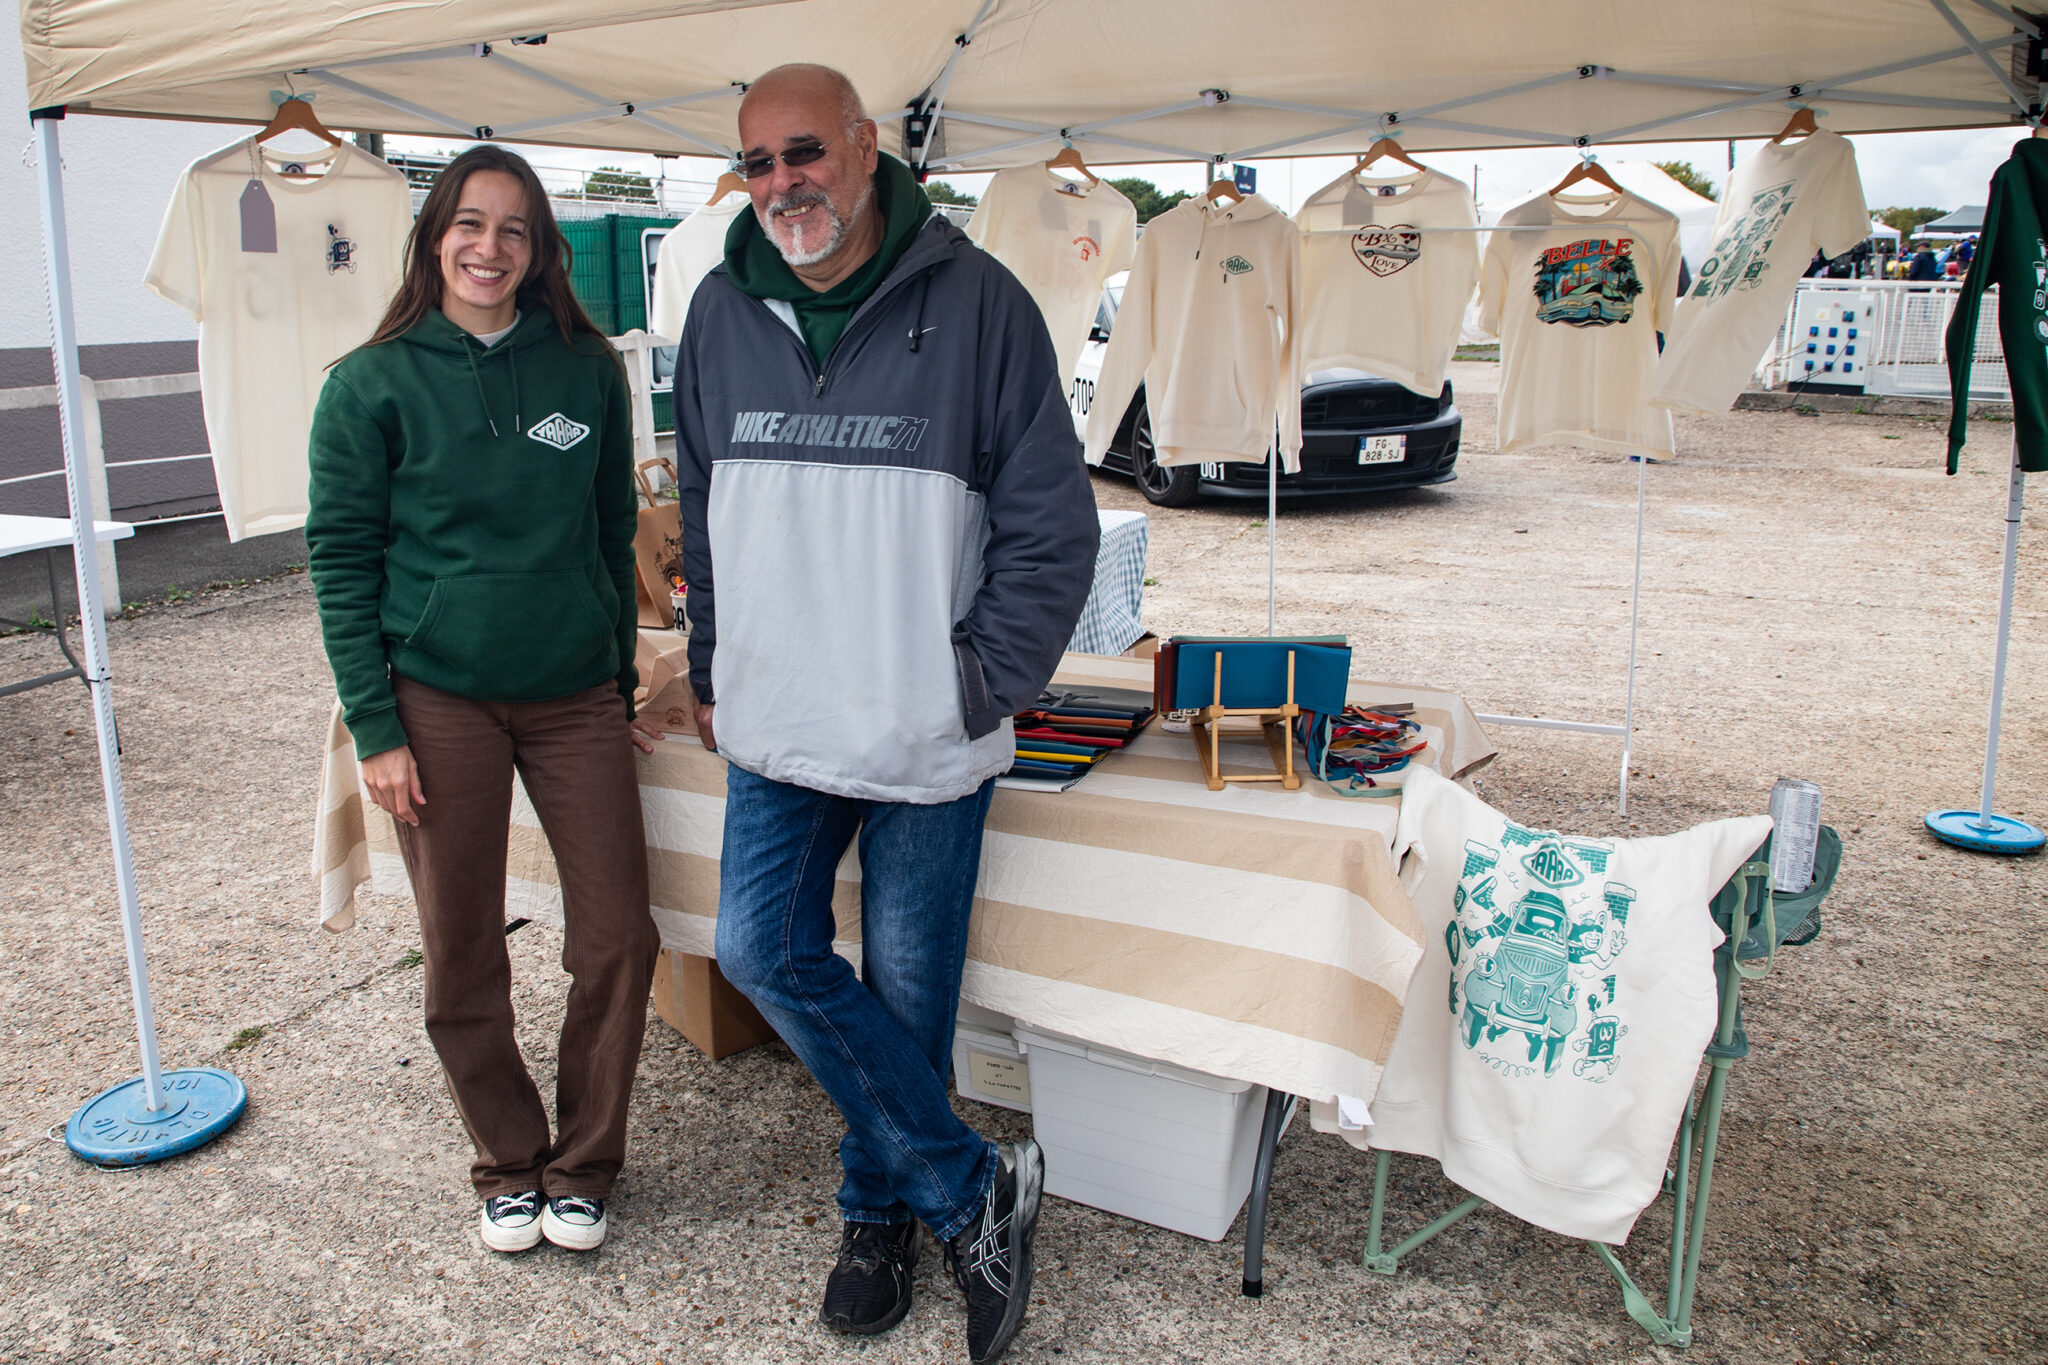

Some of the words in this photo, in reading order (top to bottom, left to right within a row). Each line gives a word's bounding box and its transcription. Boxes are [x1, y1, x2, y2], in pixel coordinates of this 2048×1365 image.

[1543, 239, 1634, 265] BELLE
[1371, 256, 1398, 272] LOVE
[1598, 256, 1615, 271] X
[1201, 462, 1224, 480] 001
